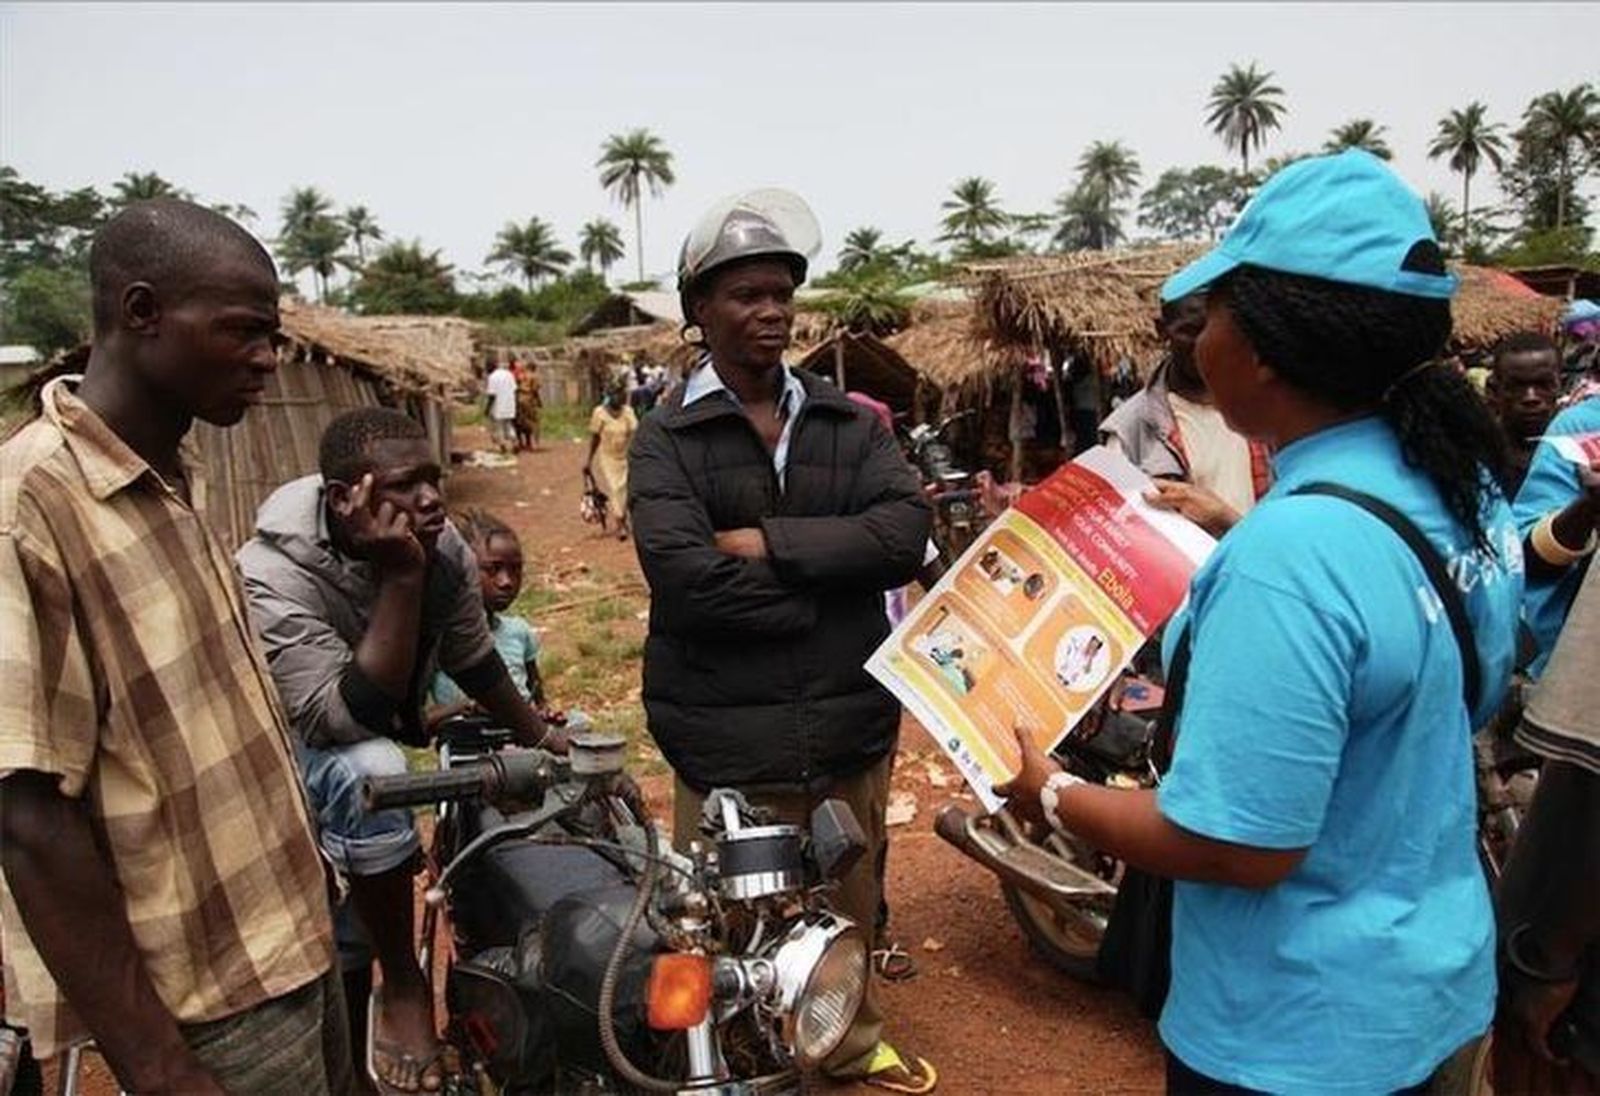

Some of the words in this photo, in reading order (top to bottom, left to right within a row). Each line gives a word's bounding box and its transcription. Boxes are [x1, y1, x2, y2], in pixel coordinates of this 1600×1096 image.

[1069, 511, 1094, 536] YOUR
[1089, 531, 1139, 582] COMMUNITY
[1096, 566, 1137, 610] Ebola
